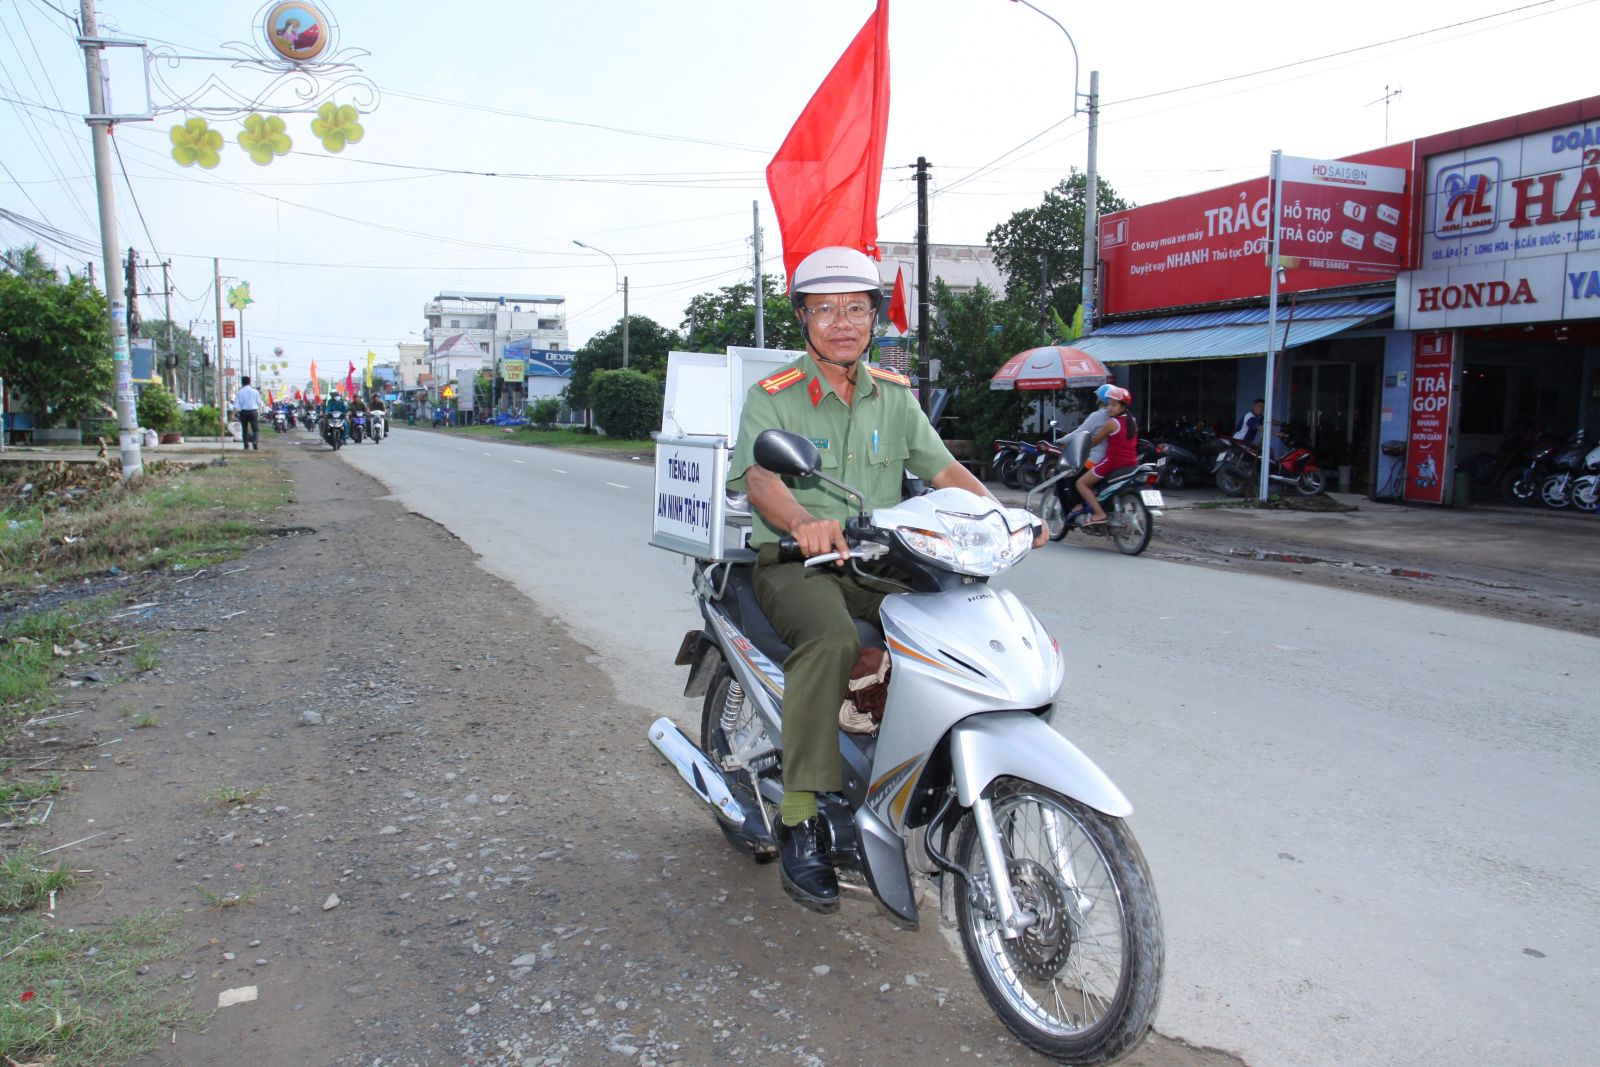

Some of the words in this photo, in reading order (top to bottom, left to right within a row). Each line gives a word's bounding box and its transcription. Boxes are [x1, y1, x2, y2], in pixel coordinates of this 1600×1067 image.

[1328, 166, 1368, 180] SAISON
[1132, 241, 1146, 252] Cho
[1146, 239, 1159, 251] vay
[1160, 237, 1176, 247] mua
[1177, 235, 1187, 244] xe
[1187, 229, 1203, 243] máy
[1205, 192, 1251, 237] TRẢ
[1283, 200, 1302, 219] HỖ
[1305, 207, 1331, 224] TRỢ
[1279, 223, 1303, 241] TRẢ
[1307, 227, 1333, 244] GÓP
[1474, 243, 1493, 255] LONG
[1130, 263, 1152, 276] Duyệt
[1153, 262, 1166, 273] vay
[1167, 249, 1209, 269] NHANH
[1212, 248, 1228, 261] Thủ
[1229, 248, 1242, 262] tục
[1417, 278, 1537, 312] HONDA
[1416, 372, 1446, 392] TRẢ
[1413, 393, 1447, 412] GÓP
[669, 451, 686, 480] TIẾNG
[688, 462, 700, 483] LOA
[658, 493, 667, 518] AN
[668, 494, 683, 522] NINH
[685, 493, 700, 533] TRẬT
